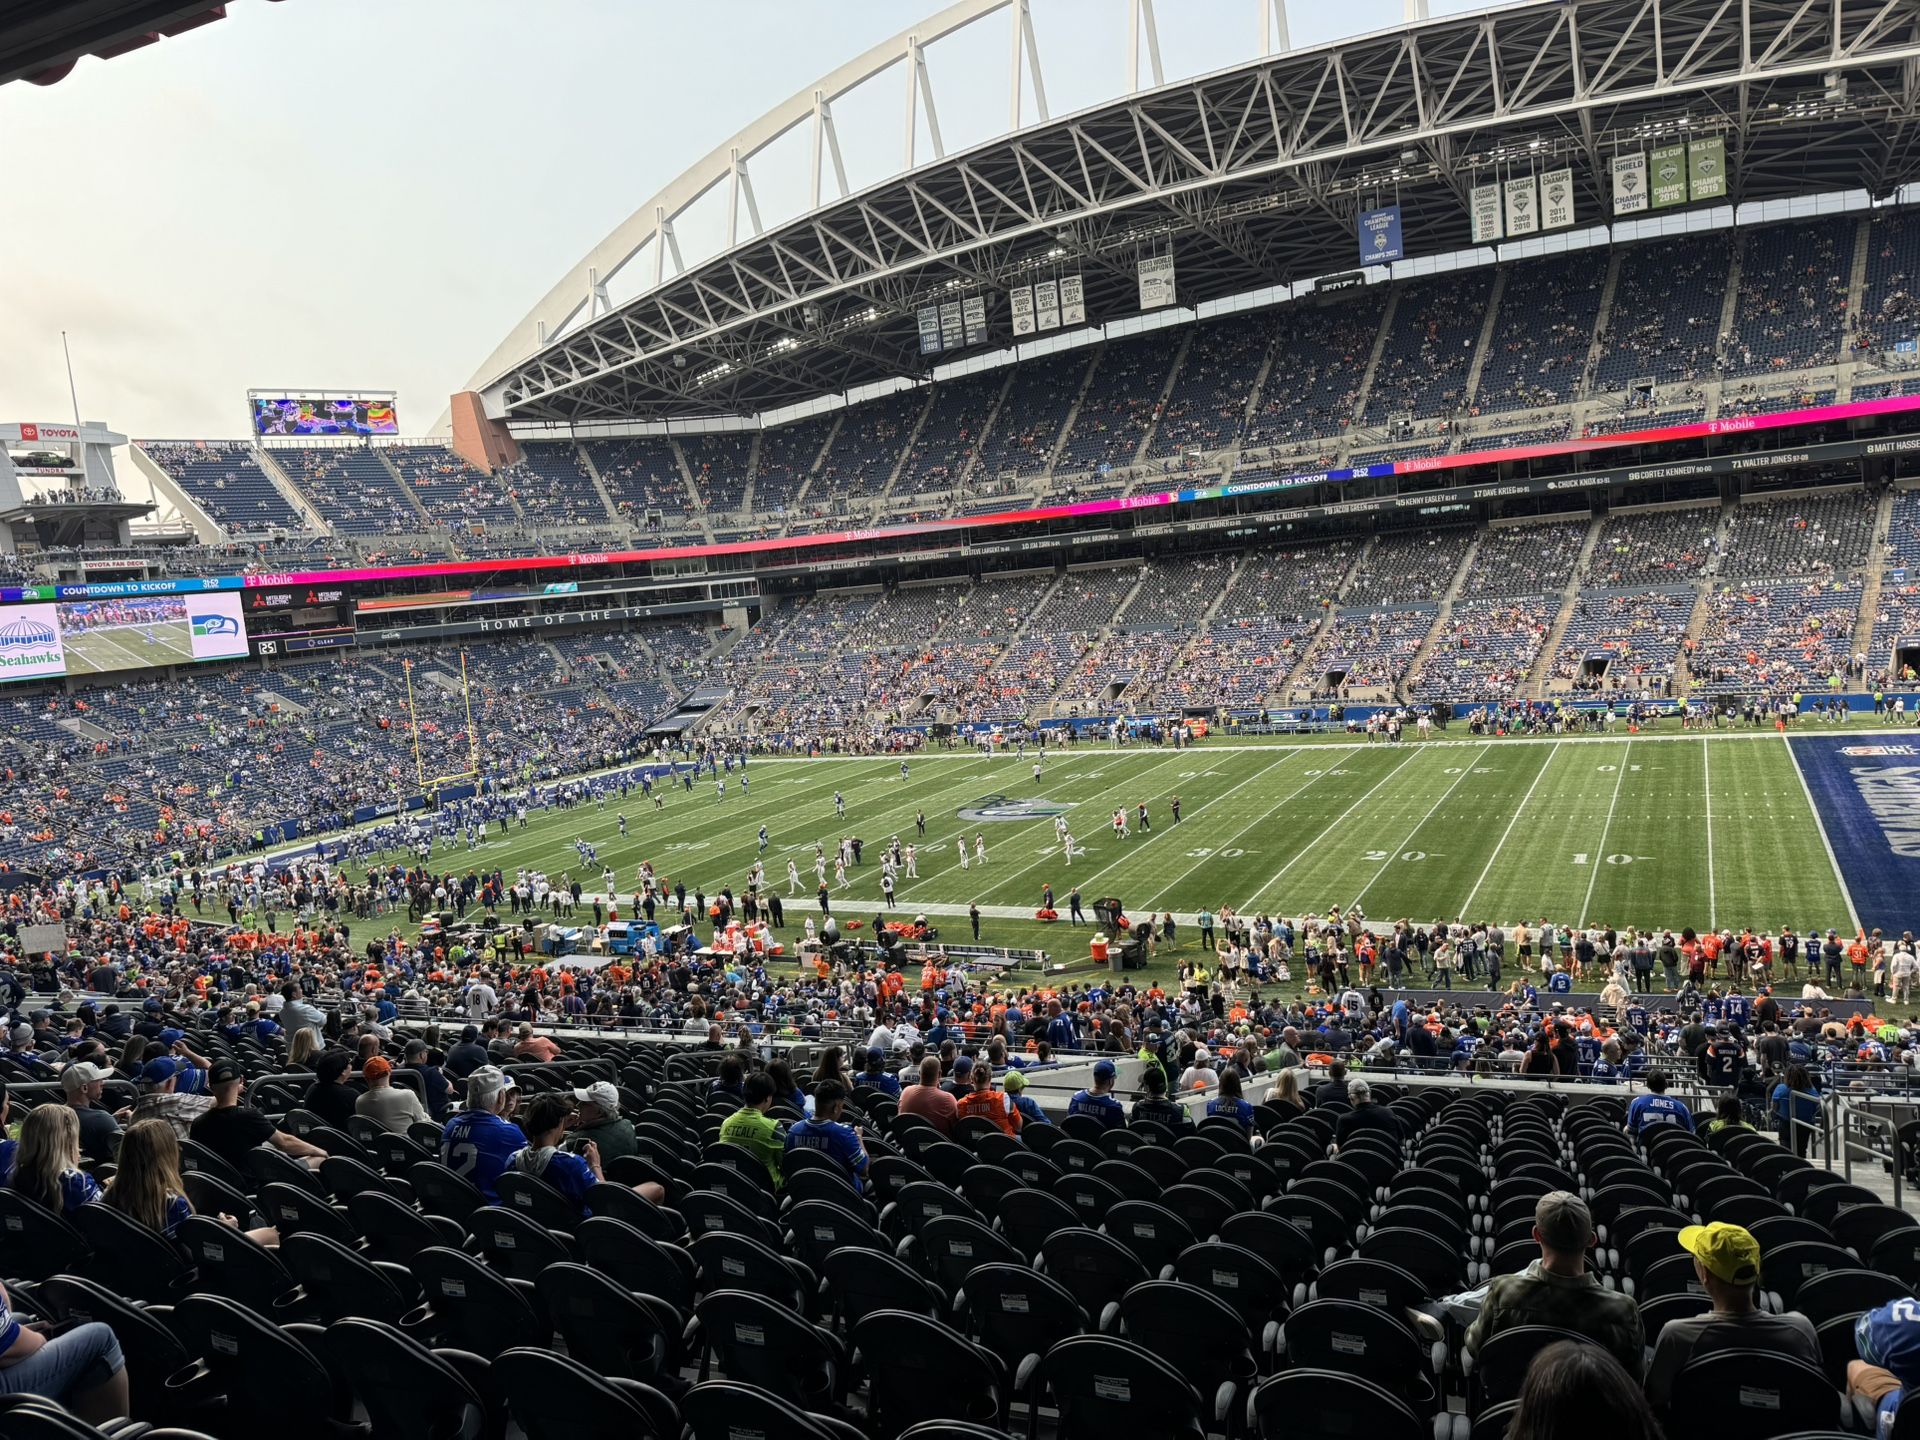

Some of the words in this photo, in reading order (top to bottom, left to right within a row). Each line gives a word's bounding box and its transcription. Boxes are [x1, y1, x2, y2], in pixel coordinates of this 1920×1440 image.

[1690, 143, 1706, 152] MLS
[1707, 140, 1722, 148] CUP
[1652, 152, 1667, 160] MLS
[1668, 148, 1683, 157] CUP
[1615, 160, 1644, 172] SHIELD
[1543, 174, 1570, 186] CHAMPS
[1692, 175, 1723, 188] CHAMPS
[1508, 182, 1534, 193] CHAMPS
[1654, 183, 1684, 195] CHAMPS
[1697, 184, 1719, 194] 2019
[1615, 192, 1646, 204] CHAMPS
[1659, 192, 1680, 202] 2016
[1622, 200, 1640, 210] 2014
[1549, 207, 1566, 216] 2011
[1364, 214, 1394, 226] CHAMPIONS
[1514, 214, 1530, 223] 2009
[1550, 215, 1566, 224] 2014
[1370, 222, 1388, 231] LEAGUE
[1514, 222, 1530, 231] 2010
[1365, 252, 1385, 262] CHAMPS
[1138, 260, 1153, 269] 2013
[1140, 263, 1172, 274] CHAMPIONS
[1039, 292, 1054, 302] 2013
[1064, 287, 1080, 296] 2014
[1709, 424, 1718, 432] T
[1720, 420, 1755, 432] Mobile
[40, 428, 78, 438] TOYOTA
[1867, 445, 1874, 454] 8
[1874, 442, 1895, 452] MATT
[1414, 460, 1442, 470] Mobile
[1732, 460, 1742, 469] 71
[1742, 456, 1770, 468] WALTER
[1770, 454, 1792, 464] JONES
[1628, 472, 1640, 480] 96
[1640, 469, 1664, 480] CORTEZ
[1666, 466, 1696, 476] KENNEDY
[1228, 480, 1280, 493] COUNTDOWN
[1282, 480, 1292, 488] TO
[1294, 474, 1328, 485] KICKOFF
[1558, 478, 1578, 488] CHUCK
[1580, 478, 1596, 487] KNOX
[1474, 490, 1482, 498] 17
[1482, 488, 1497, 497] DAVE
[1498, 486, 1516, 496] KRIEG
[1130, 496, 1160, 508] Mobile
[1406, 496, 1424, 506] KENNY
[1424, 494, 1444, 504] EASLEY
[854, 528, 880, 538] Mobile
[578, 554, 608, 563] Mobile
[248, 576, 256, 586] T
[257, 574, 293, 586] Mobile
[62, 584, 124, 596] COUNTDOWN
[127, 584, 138, 592] TO
[141, 582, 176, 591] KICKOFF
[318, 590, 342, 598] MITSUBISHI
[480, 618, 532, 630] HOME
[544, 614, 565, 625] OF
[579, 612, 610, 622] THE
[624, 608, 652, 618] 12s
[261, 643, 274, 652] 25
[0, 651, 60, 667] Seahawks
[1557, 980, 1566, 989] 12
[472, 992, 481, 1006] 18
[1348, 1000, 1358, 1010] 15
[1730, 1004, 1742, 1015] 14
[1631, 1014, 1642, 1025] 16
[1885, 1030, 1896, 1042] 14
[1578, 1048, 1596, 1062] 14
[1722, 1056, 1732, 1072] 2
[966, 1102, 991, 1114] SUTTON
[1078, 1102, 1100, 1115] WALKER
[1215, 1104, 1238, 1114] LOCKETT
[1650, 1098, 1674, 1110] JONES
[1138, 1111, 1172, 1124] METCALF
[450, 1126, 472, 1138] FAN
[794, 1135, 821, 1148] WALKER
